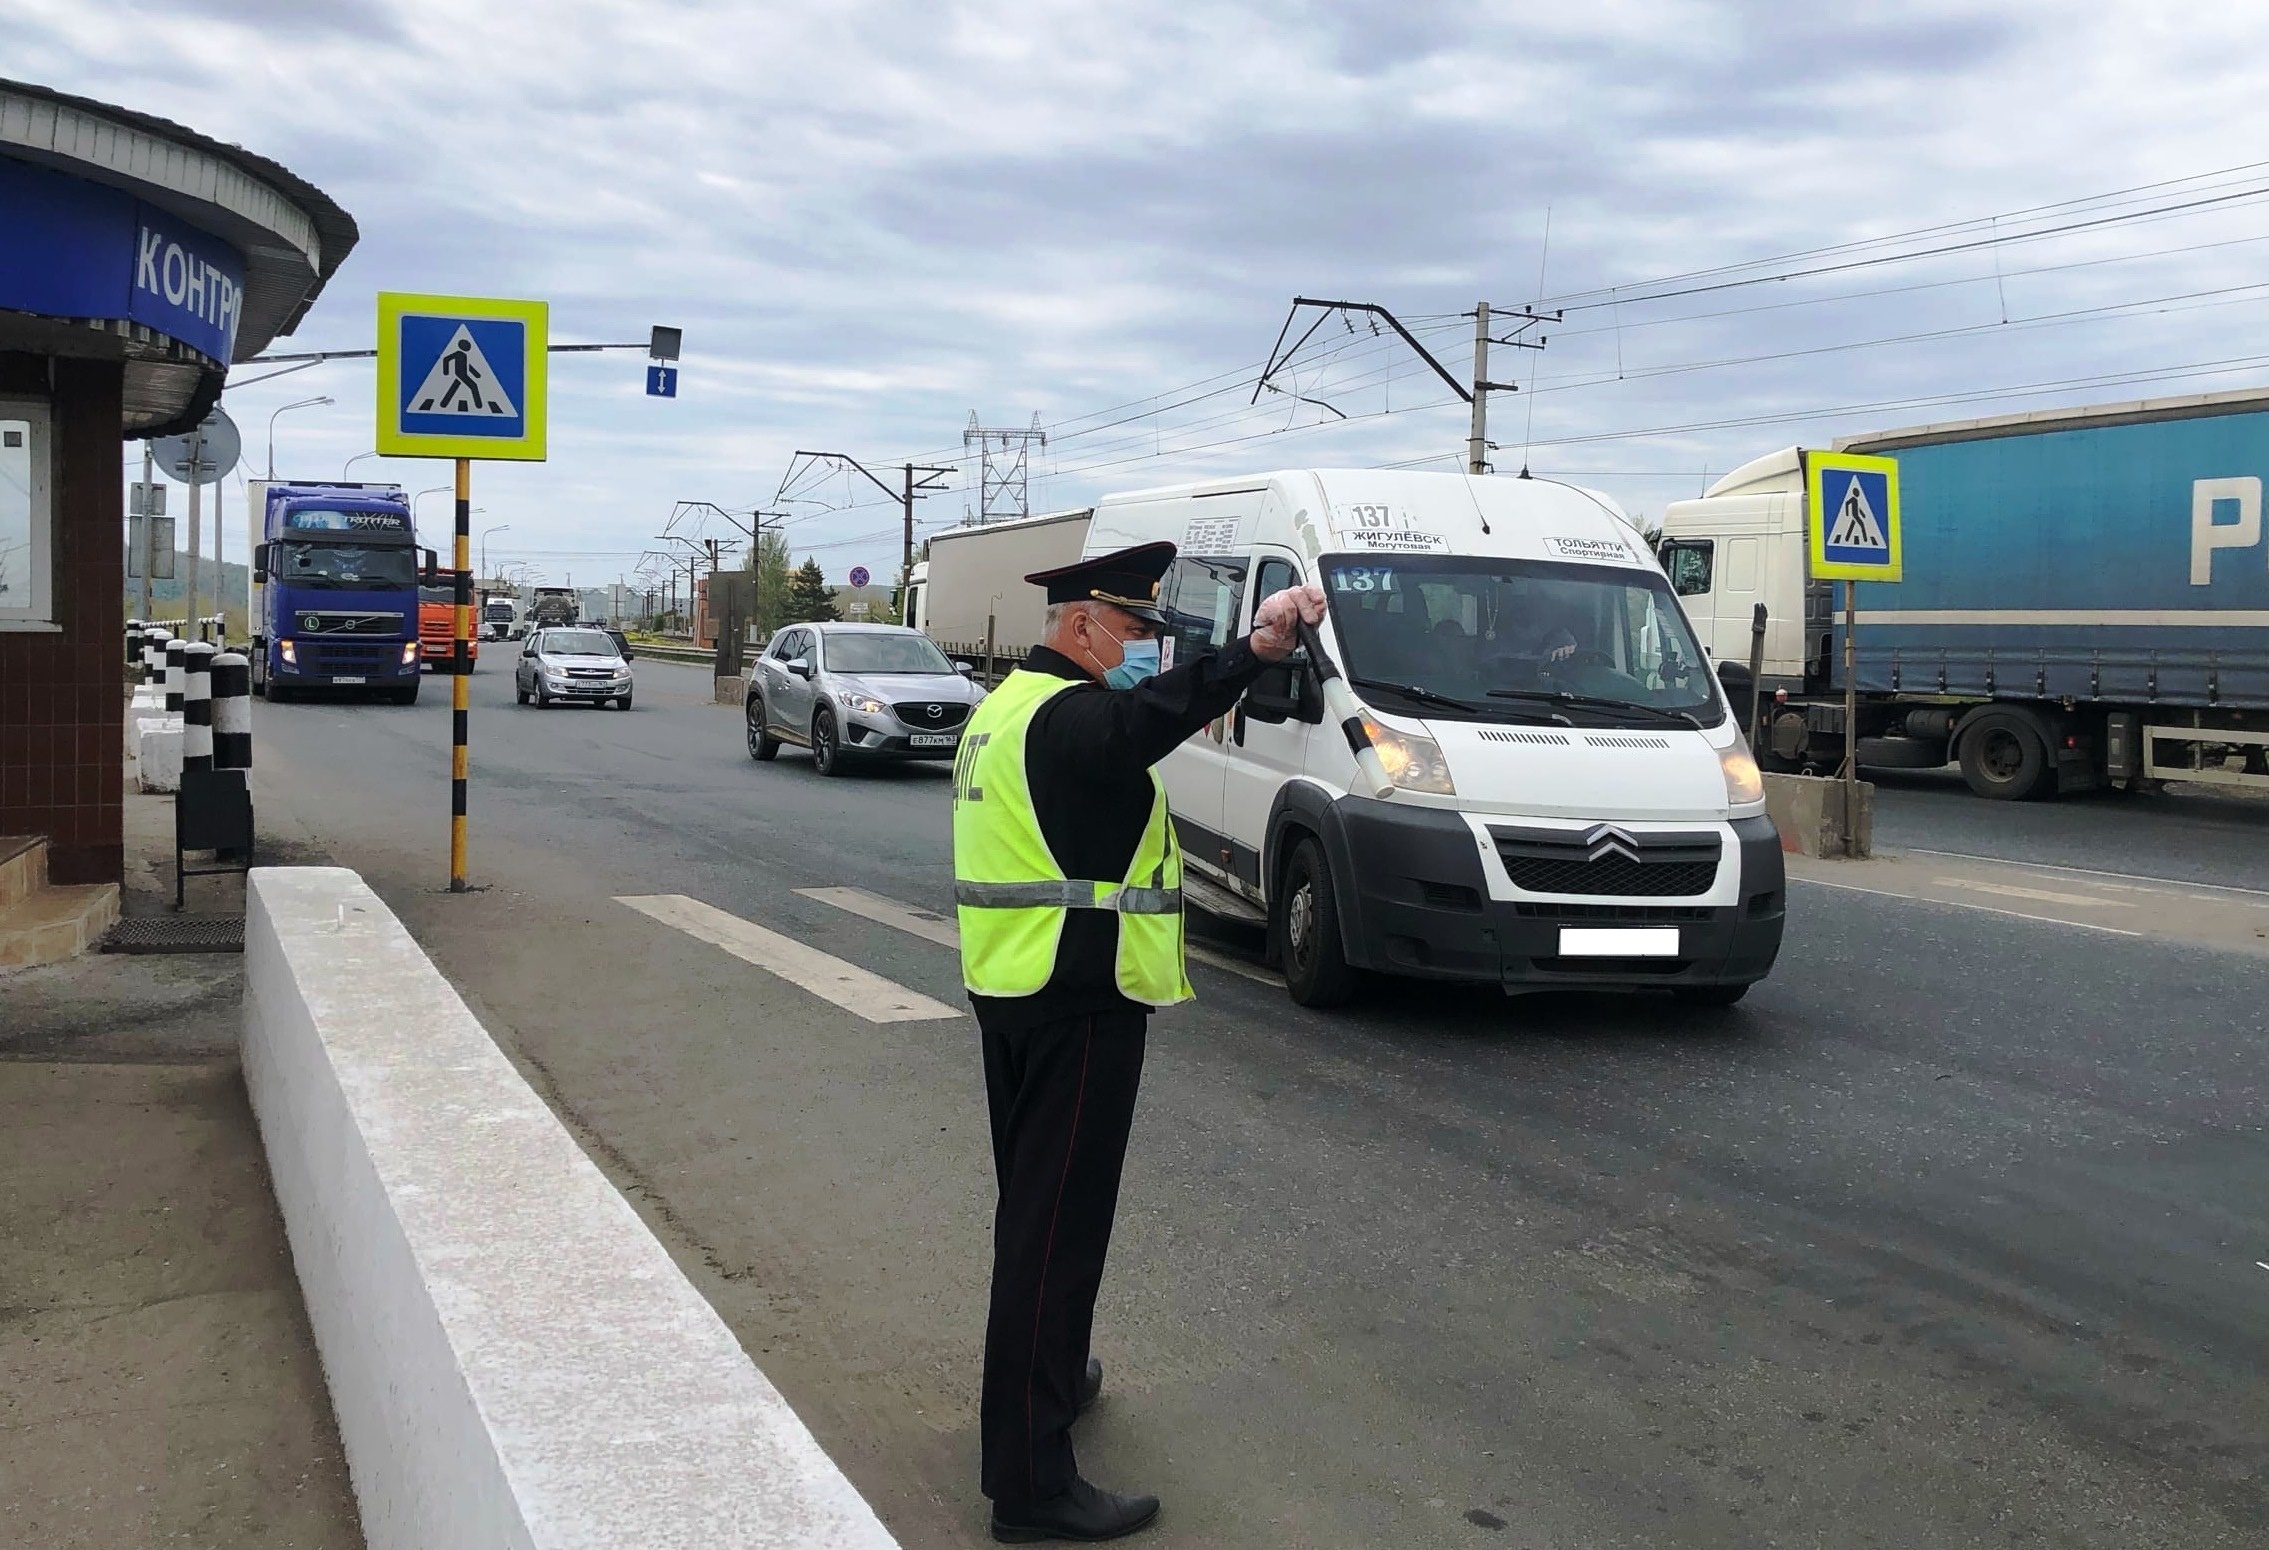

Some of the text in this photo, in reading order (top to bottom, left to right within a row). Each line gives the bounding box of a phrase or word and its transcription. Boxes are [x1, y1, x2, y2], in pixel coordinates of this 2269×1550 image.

[1352, 505, 1390, 528] 137
[1353, 531, 1442, 545] ЖИГУЛЁВСК
[1367, 541, 1431, 550] Могутовая
[1554, 539, 1624, 552] ТОЛЬЯТТИ
[1560, 547, 1625, 559] Спортивная
[1332, 566, 1393, 591] 137
